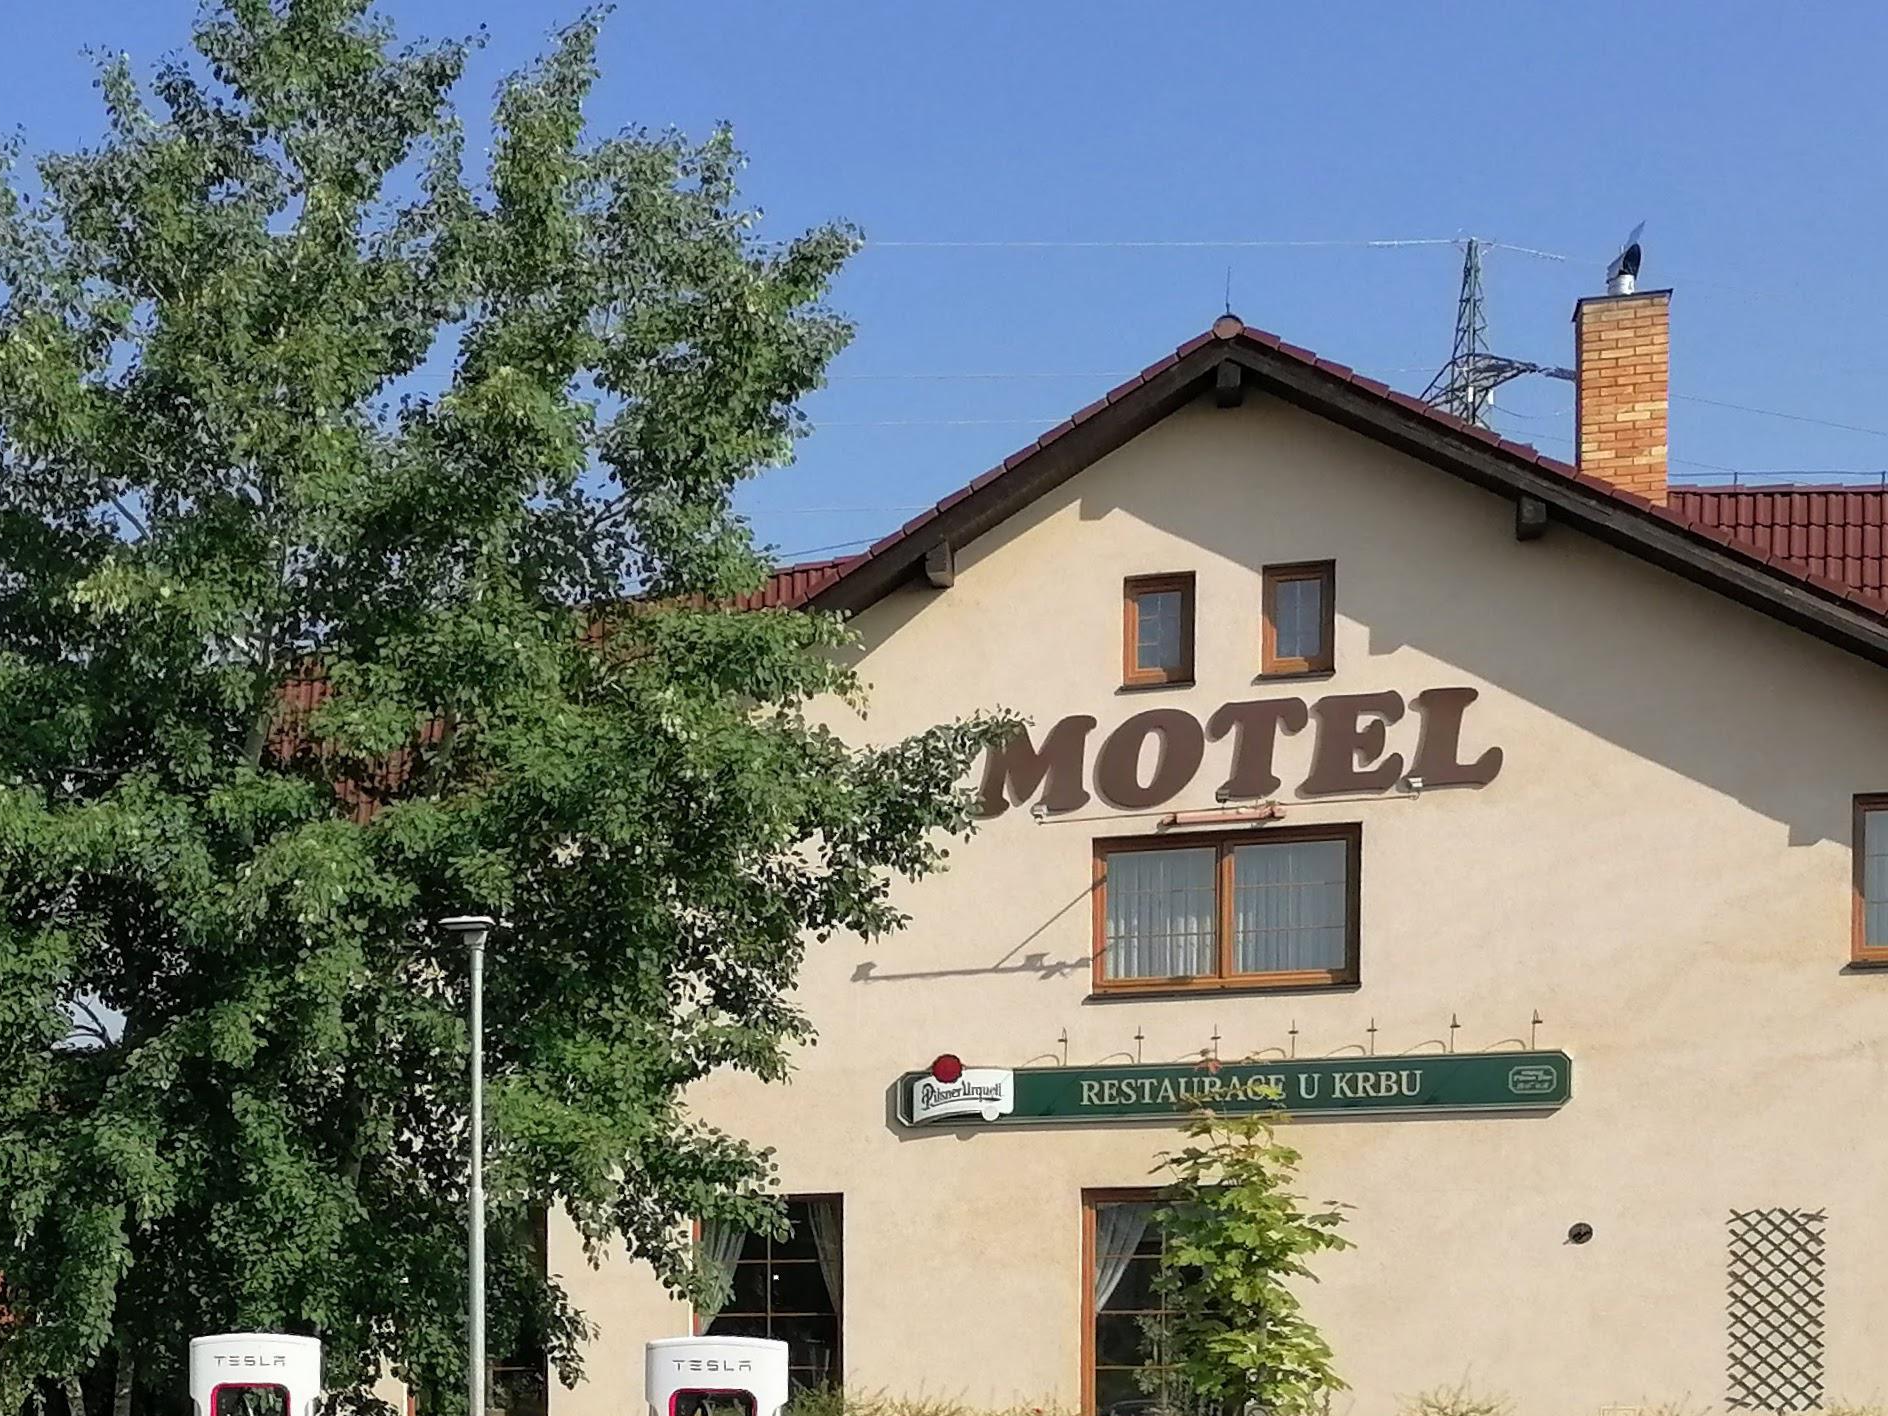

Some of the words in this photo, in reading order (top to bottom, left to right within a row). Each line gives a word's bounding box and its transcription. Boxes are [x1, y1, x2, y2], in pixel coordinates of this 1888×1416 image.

[966, 686, 1503, 820] MOTEL
[921, 1082, 962, 1111] Pilsner
[962, 1080, 1002, 1103] Urquell
[1299, 1073, 1322, 1099] U
[1332, 1070, 1423, 1098] KRBU
[213, 1355, 286, 1367] TESLA
[671, 1359, 752, 1372] TESLA
